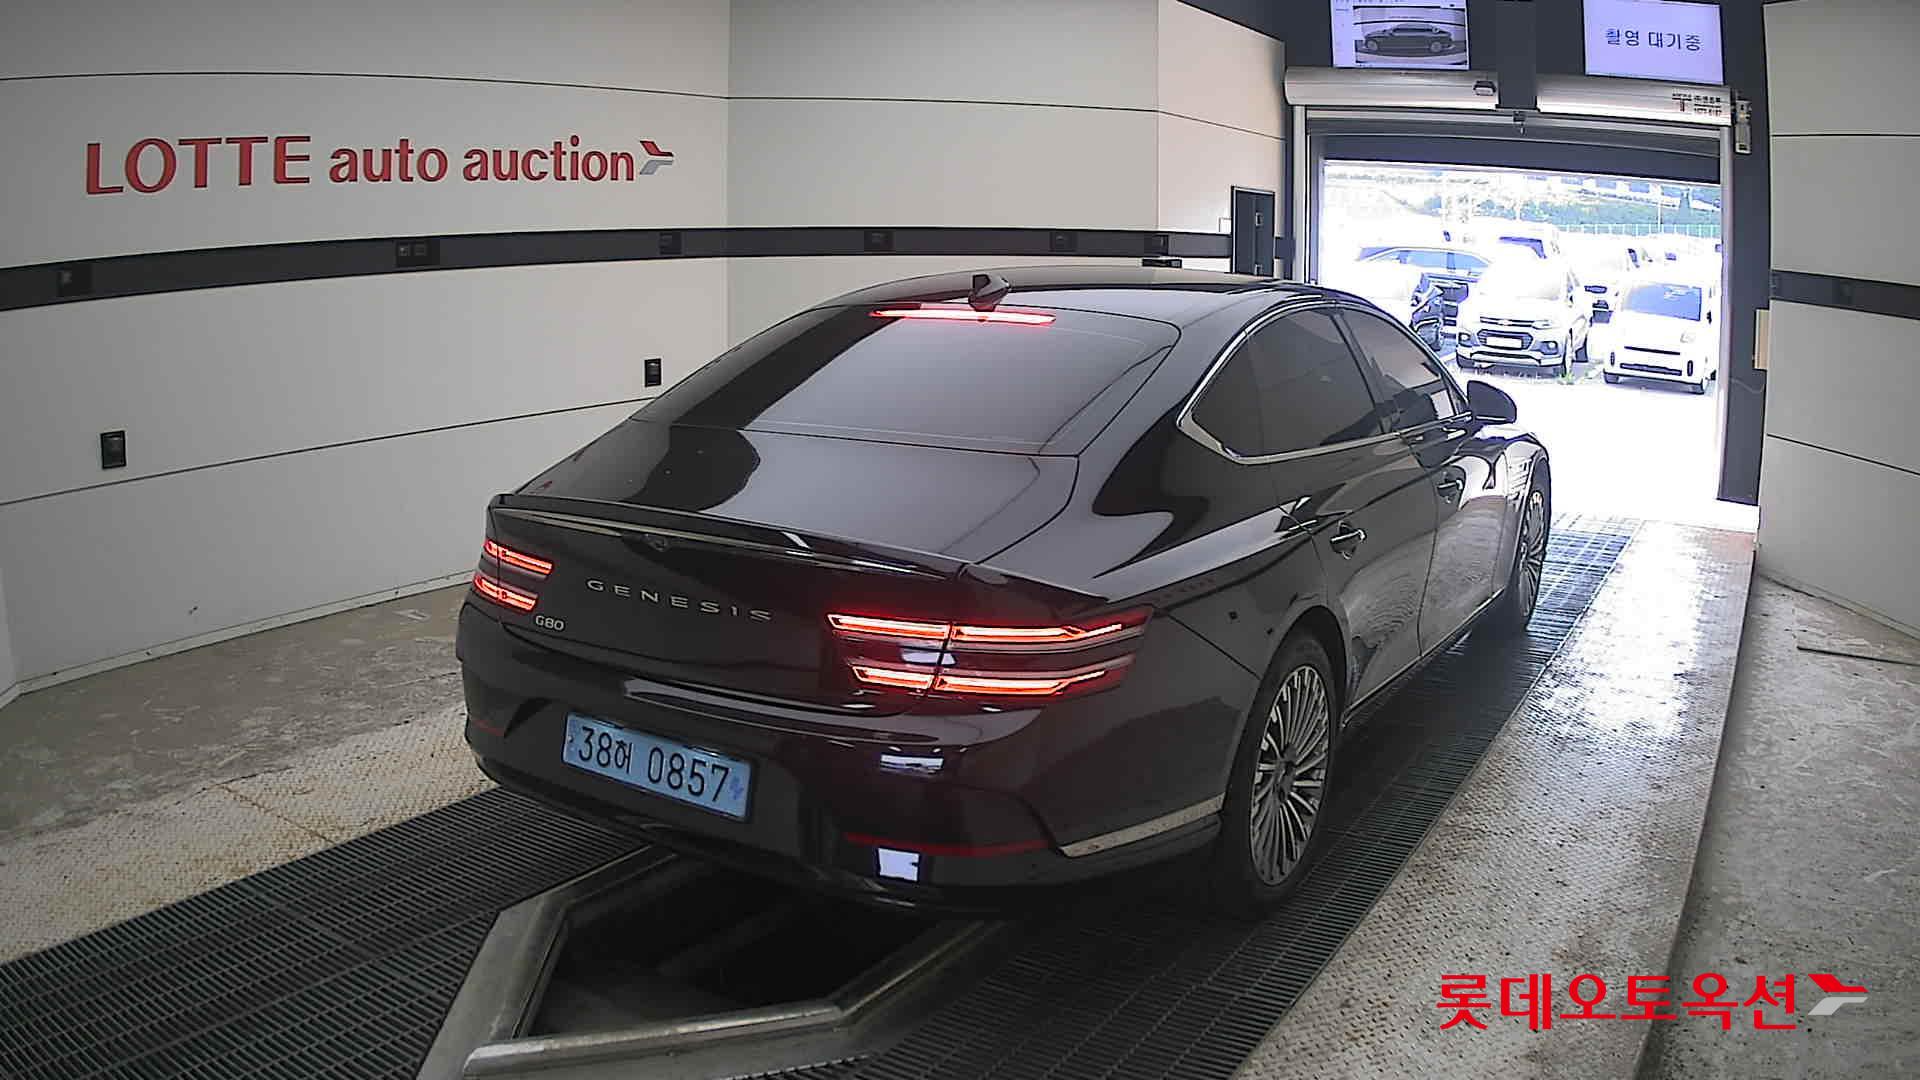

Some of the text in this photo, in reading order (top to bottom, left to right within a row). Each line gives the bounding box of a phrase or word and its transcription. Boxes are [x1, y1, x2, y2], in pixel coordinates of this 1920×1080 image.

[1648, 31, 1701, 51] 대기중
[85, 134, 635, 195] LOTTE auto auction
[586, 578, 773, 622] GENESIS
[534, 614, 565, 632] G80
[578, 726, 731, 802] 38허 0857
